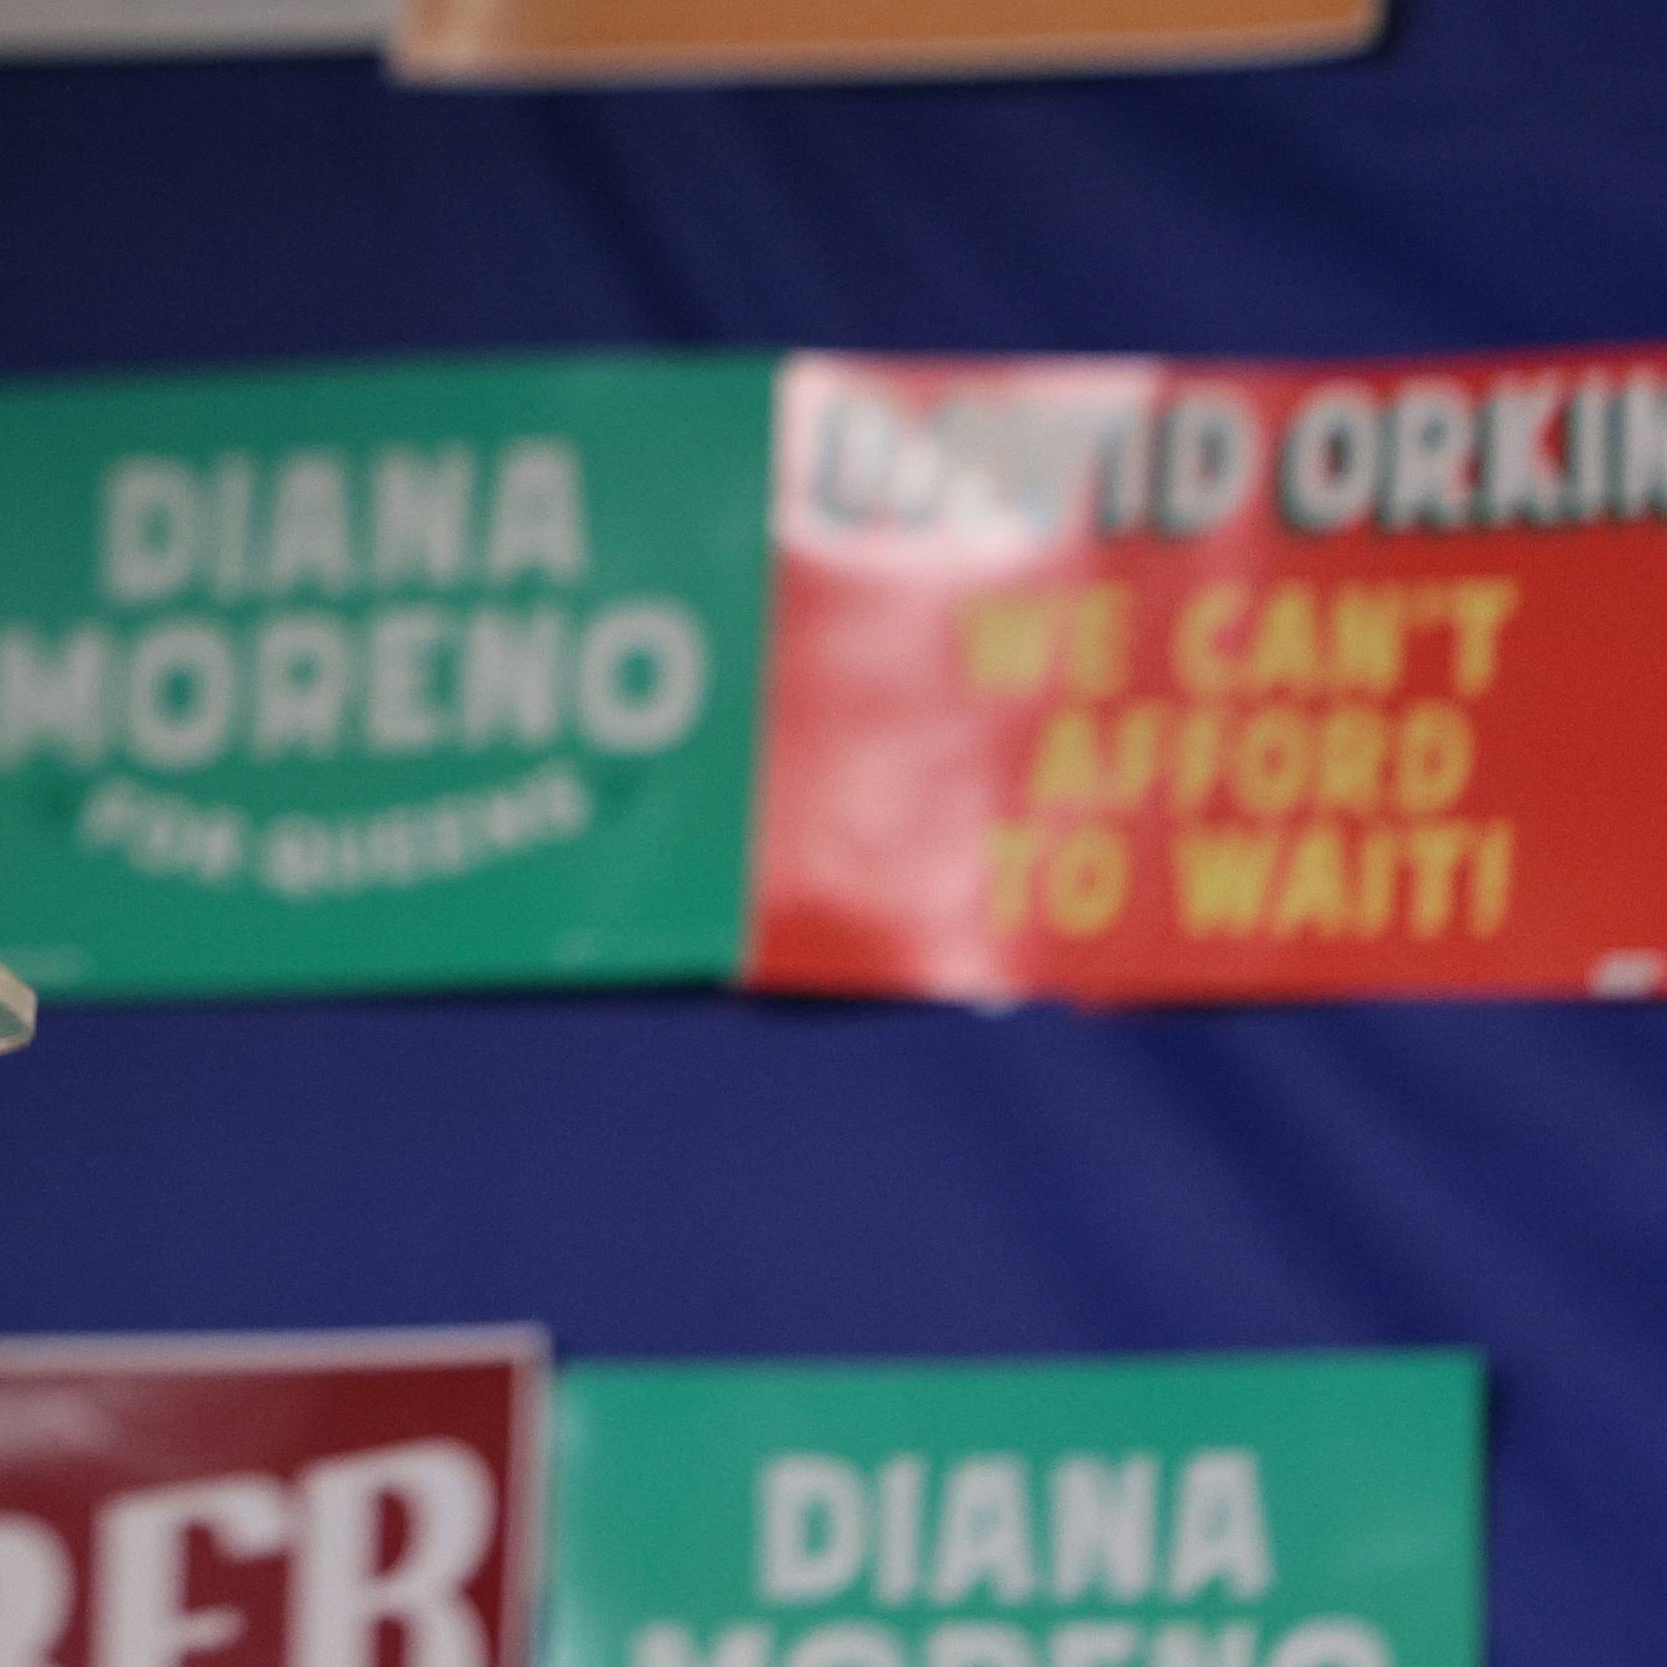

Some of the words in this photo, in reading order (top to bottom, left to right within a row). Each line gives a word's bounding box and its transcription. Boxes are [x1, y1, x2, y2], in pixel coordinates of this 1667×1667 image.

[105, 437, 590, 603] DIANA
[958, 581, 1130, 696] WE
[1173, 577, 1519, 697] CAN'T
[1028, 703, 1475, 812] AFFORD
[984, 818, 1128, 936] TO
[1173, 818, 1512, 937] WAIT!
[756, 1446, 1275, 1605] DIANA
